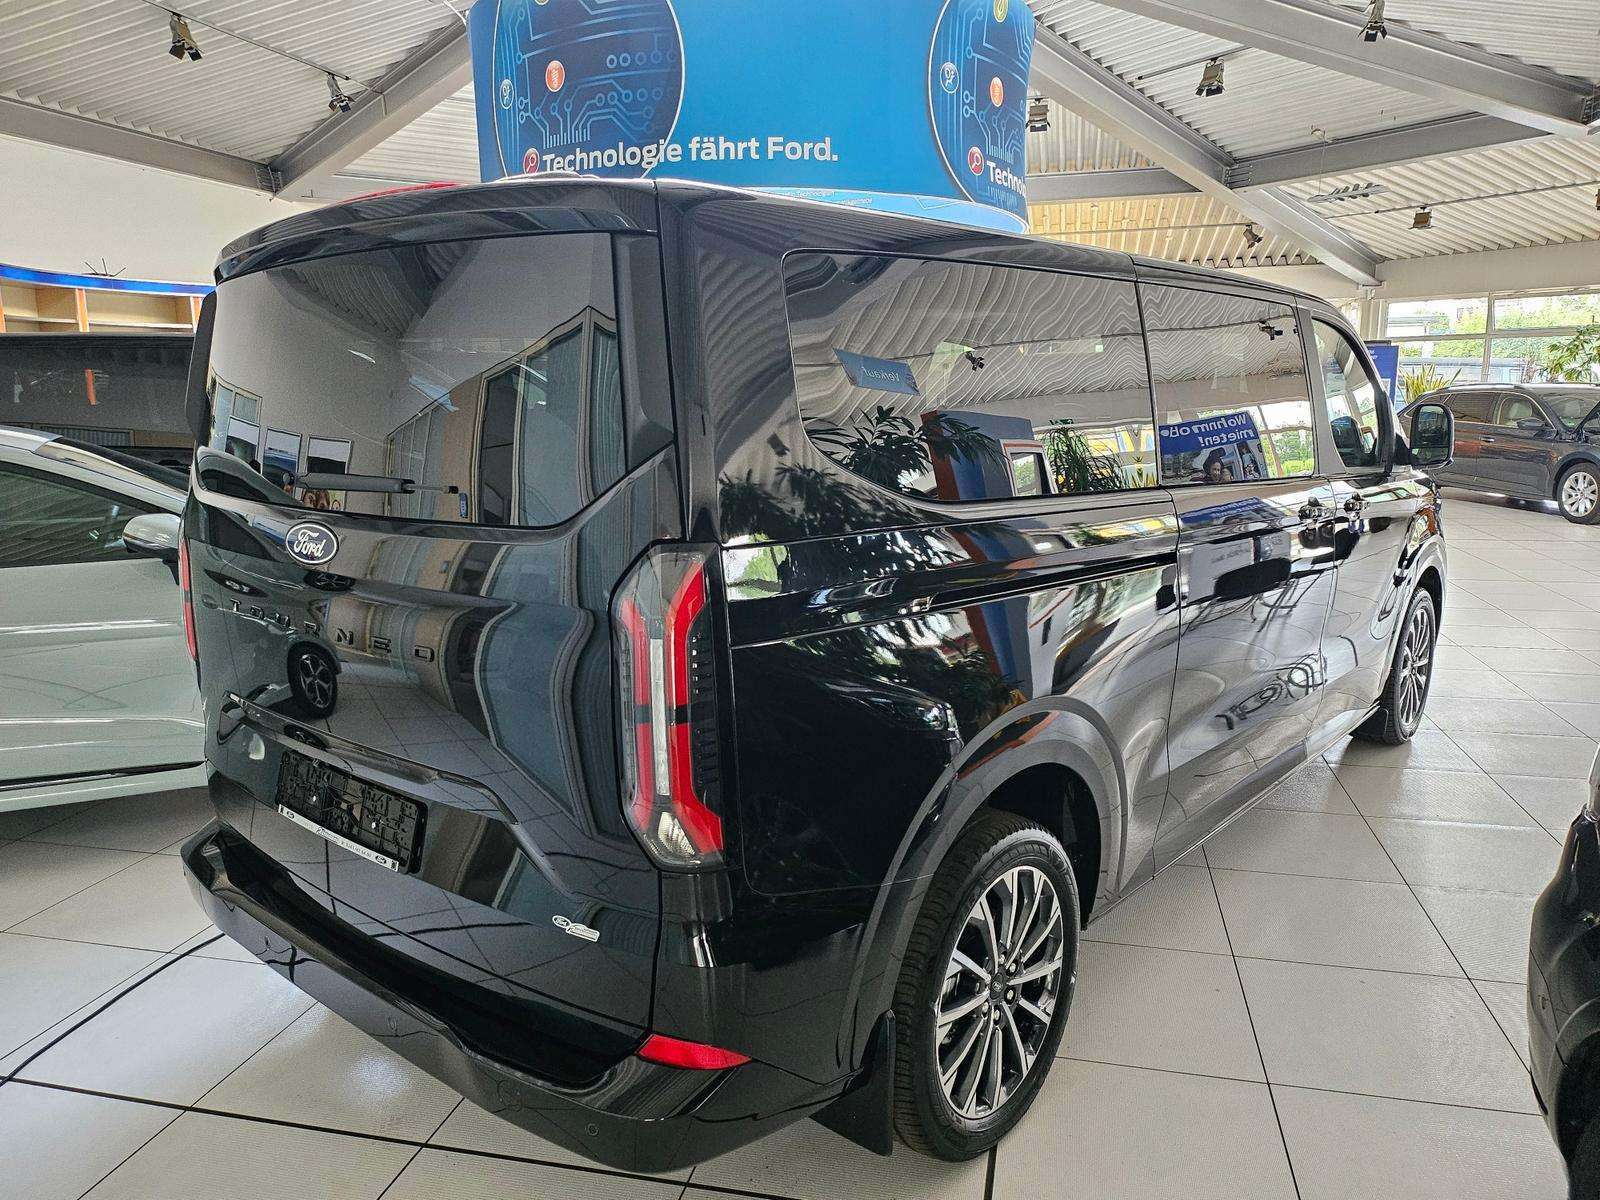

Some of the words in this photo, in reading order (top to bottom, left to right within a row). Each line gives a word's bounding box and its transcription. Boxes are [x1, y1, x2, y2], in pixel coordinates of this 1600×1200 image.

[542, 138, 683, 172] Technologie
[688, 136, 761, 161] fährt
[767, 136, 839, 161] Ford.
[293, 529, 327, 558] Ford
[230, 598, 435, 663] TOURNEO
